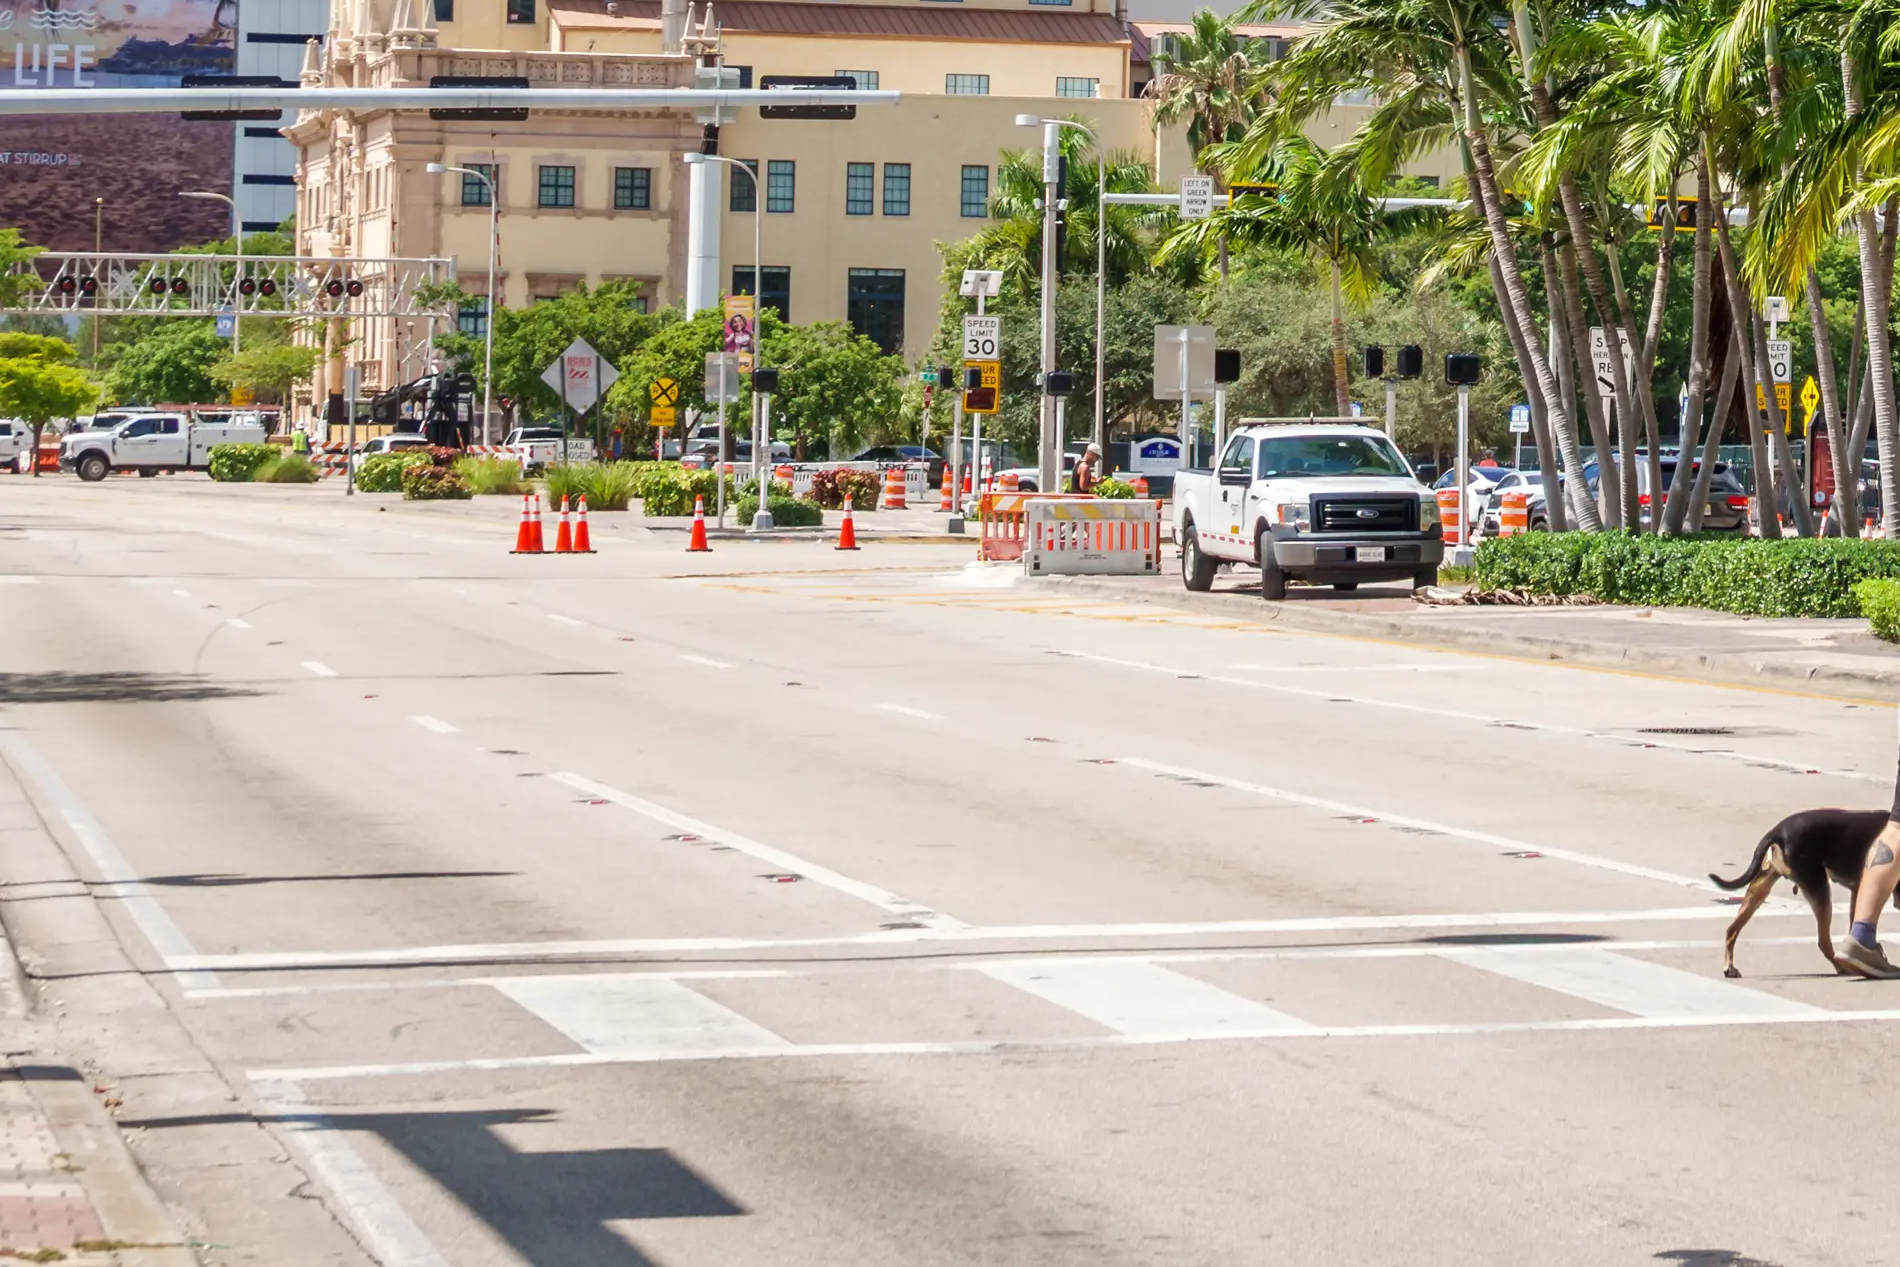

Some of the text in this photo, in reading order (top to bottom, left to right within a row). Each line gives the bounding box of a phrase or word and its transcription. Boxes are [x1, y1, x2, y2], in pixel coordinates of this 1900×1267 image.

[15, 42, 96, 87] LIFE
[14, 152, 67, 165] STIRRUP
[967, 320, 997, 328] SPEED
[970, 329, 994, 337] LIMIT
[968, 339, 995, 355] 30
[1596, 337, 1628, 348] SP
[982, 366, 995, 374] UR
[1599, 362, 1613, 374] RE
[1774, 362, 1786, 377] 0
[980, 376, 997, 384] EED
[567, 441, 586, 450] OAD
[558, 451, 590, 460] COSED
